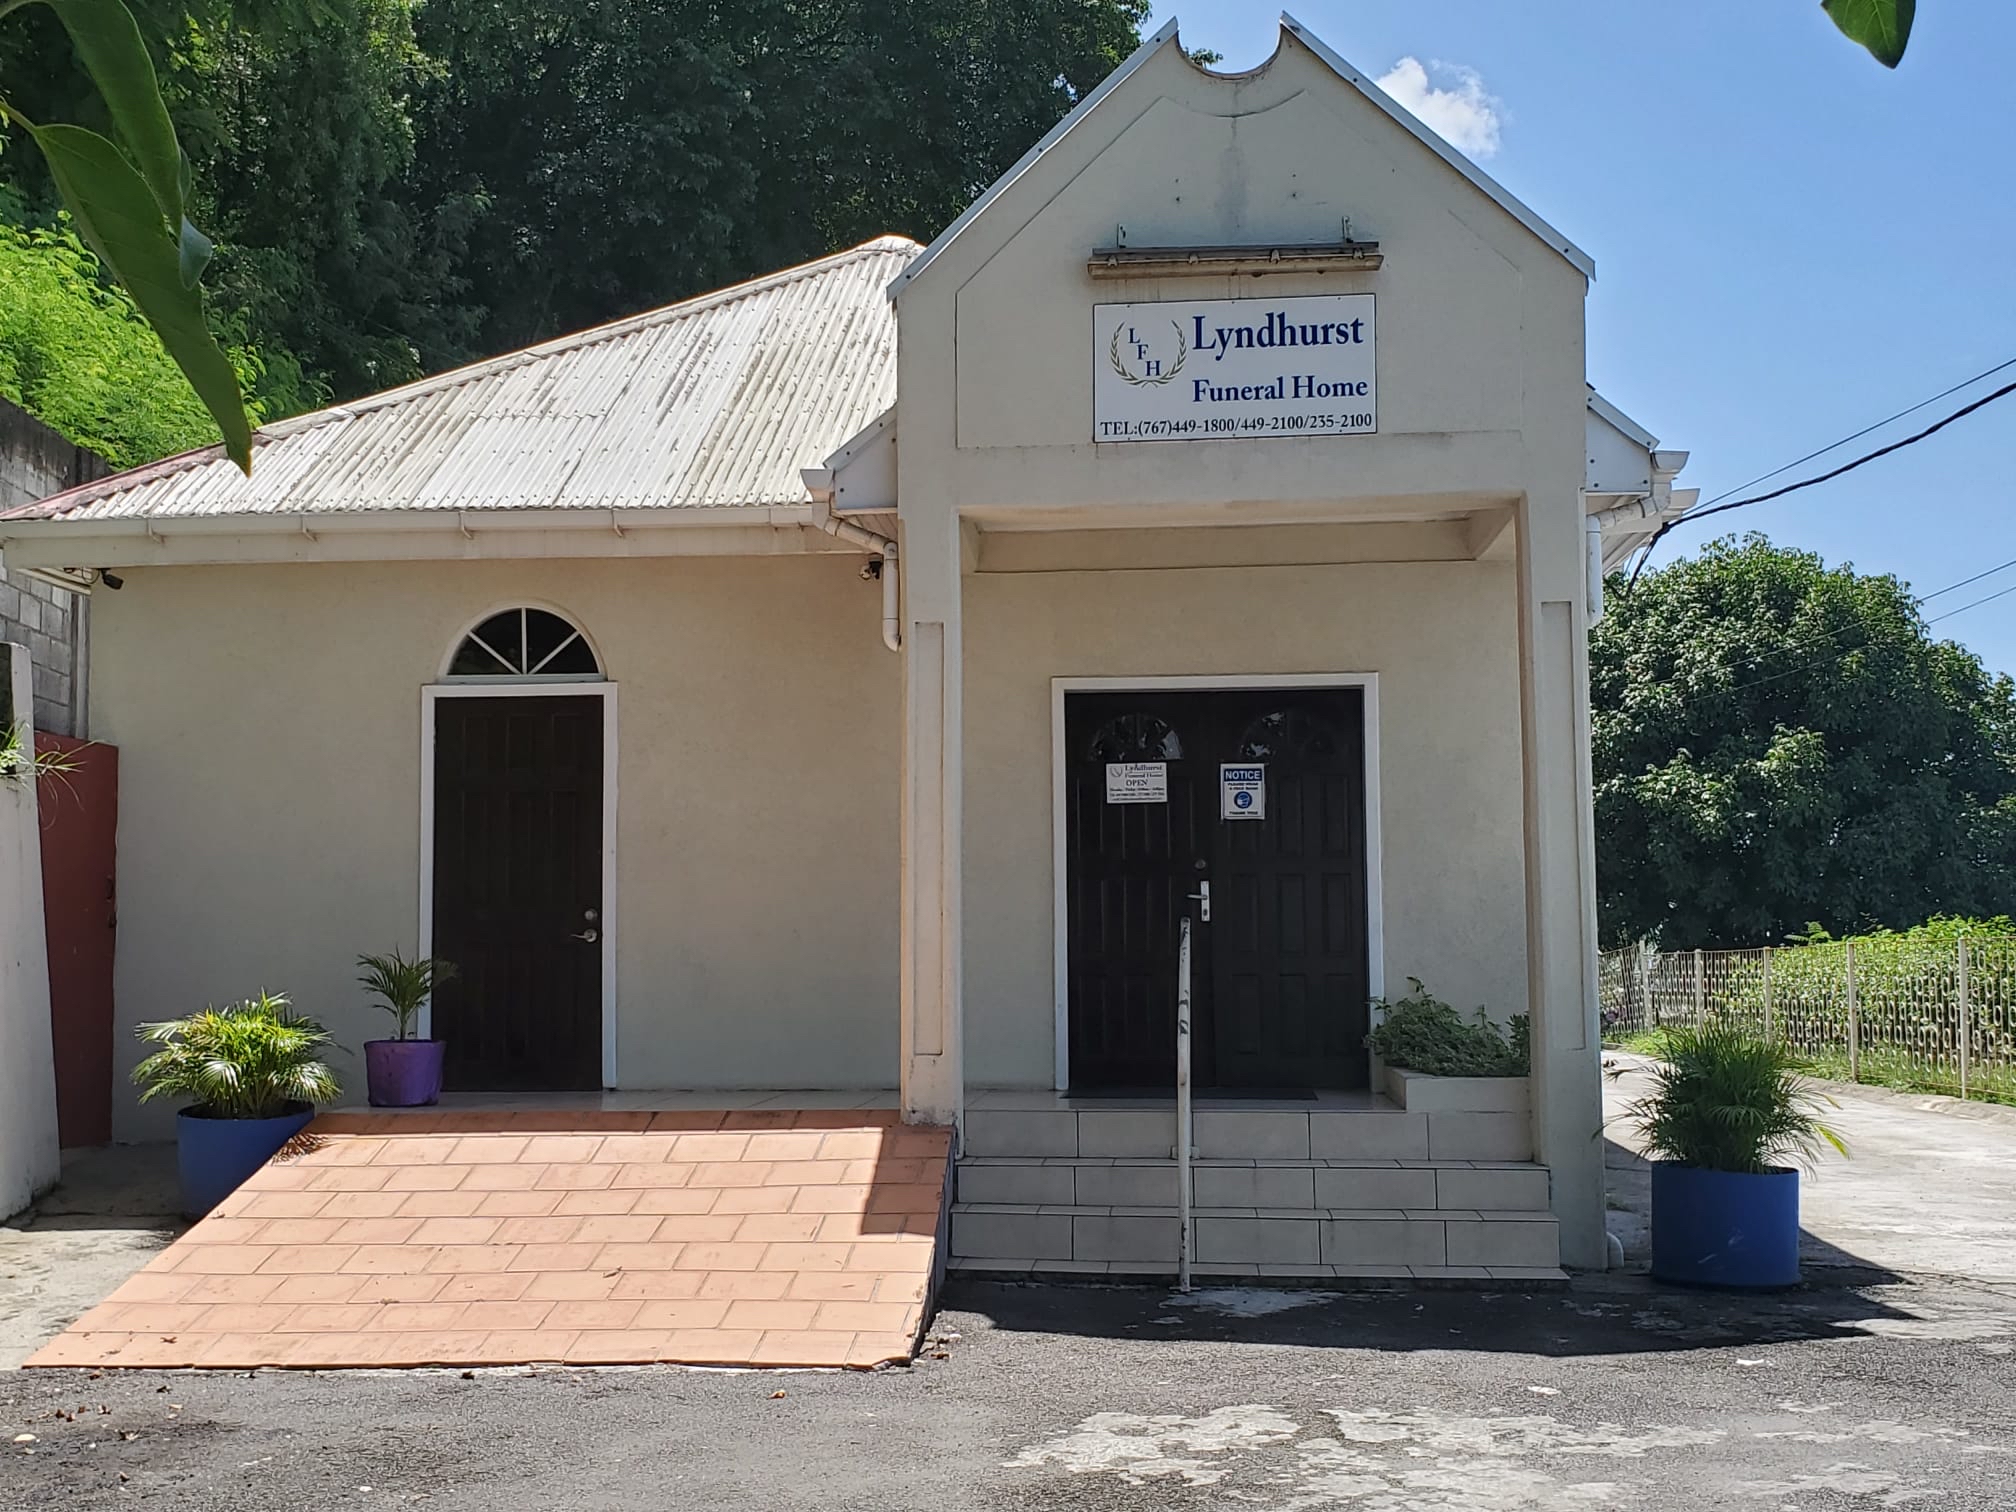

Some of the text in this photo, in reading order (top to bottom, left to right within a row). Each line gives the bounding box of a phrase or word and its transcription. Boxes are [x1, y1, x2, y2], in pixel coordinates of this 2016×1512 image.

[1128, 327, 1141, 344] L
[1192, 311, 1364, 361] Lyndhurst
[1136, 344, 1149, 360] F
[1145, 360, 1161, 377] H
[1192, 374, 1369, 403] Funeral Home
[1126, 779, 1148, 787] OPEN
[1225, 770, 1261, 780] NOTICE
